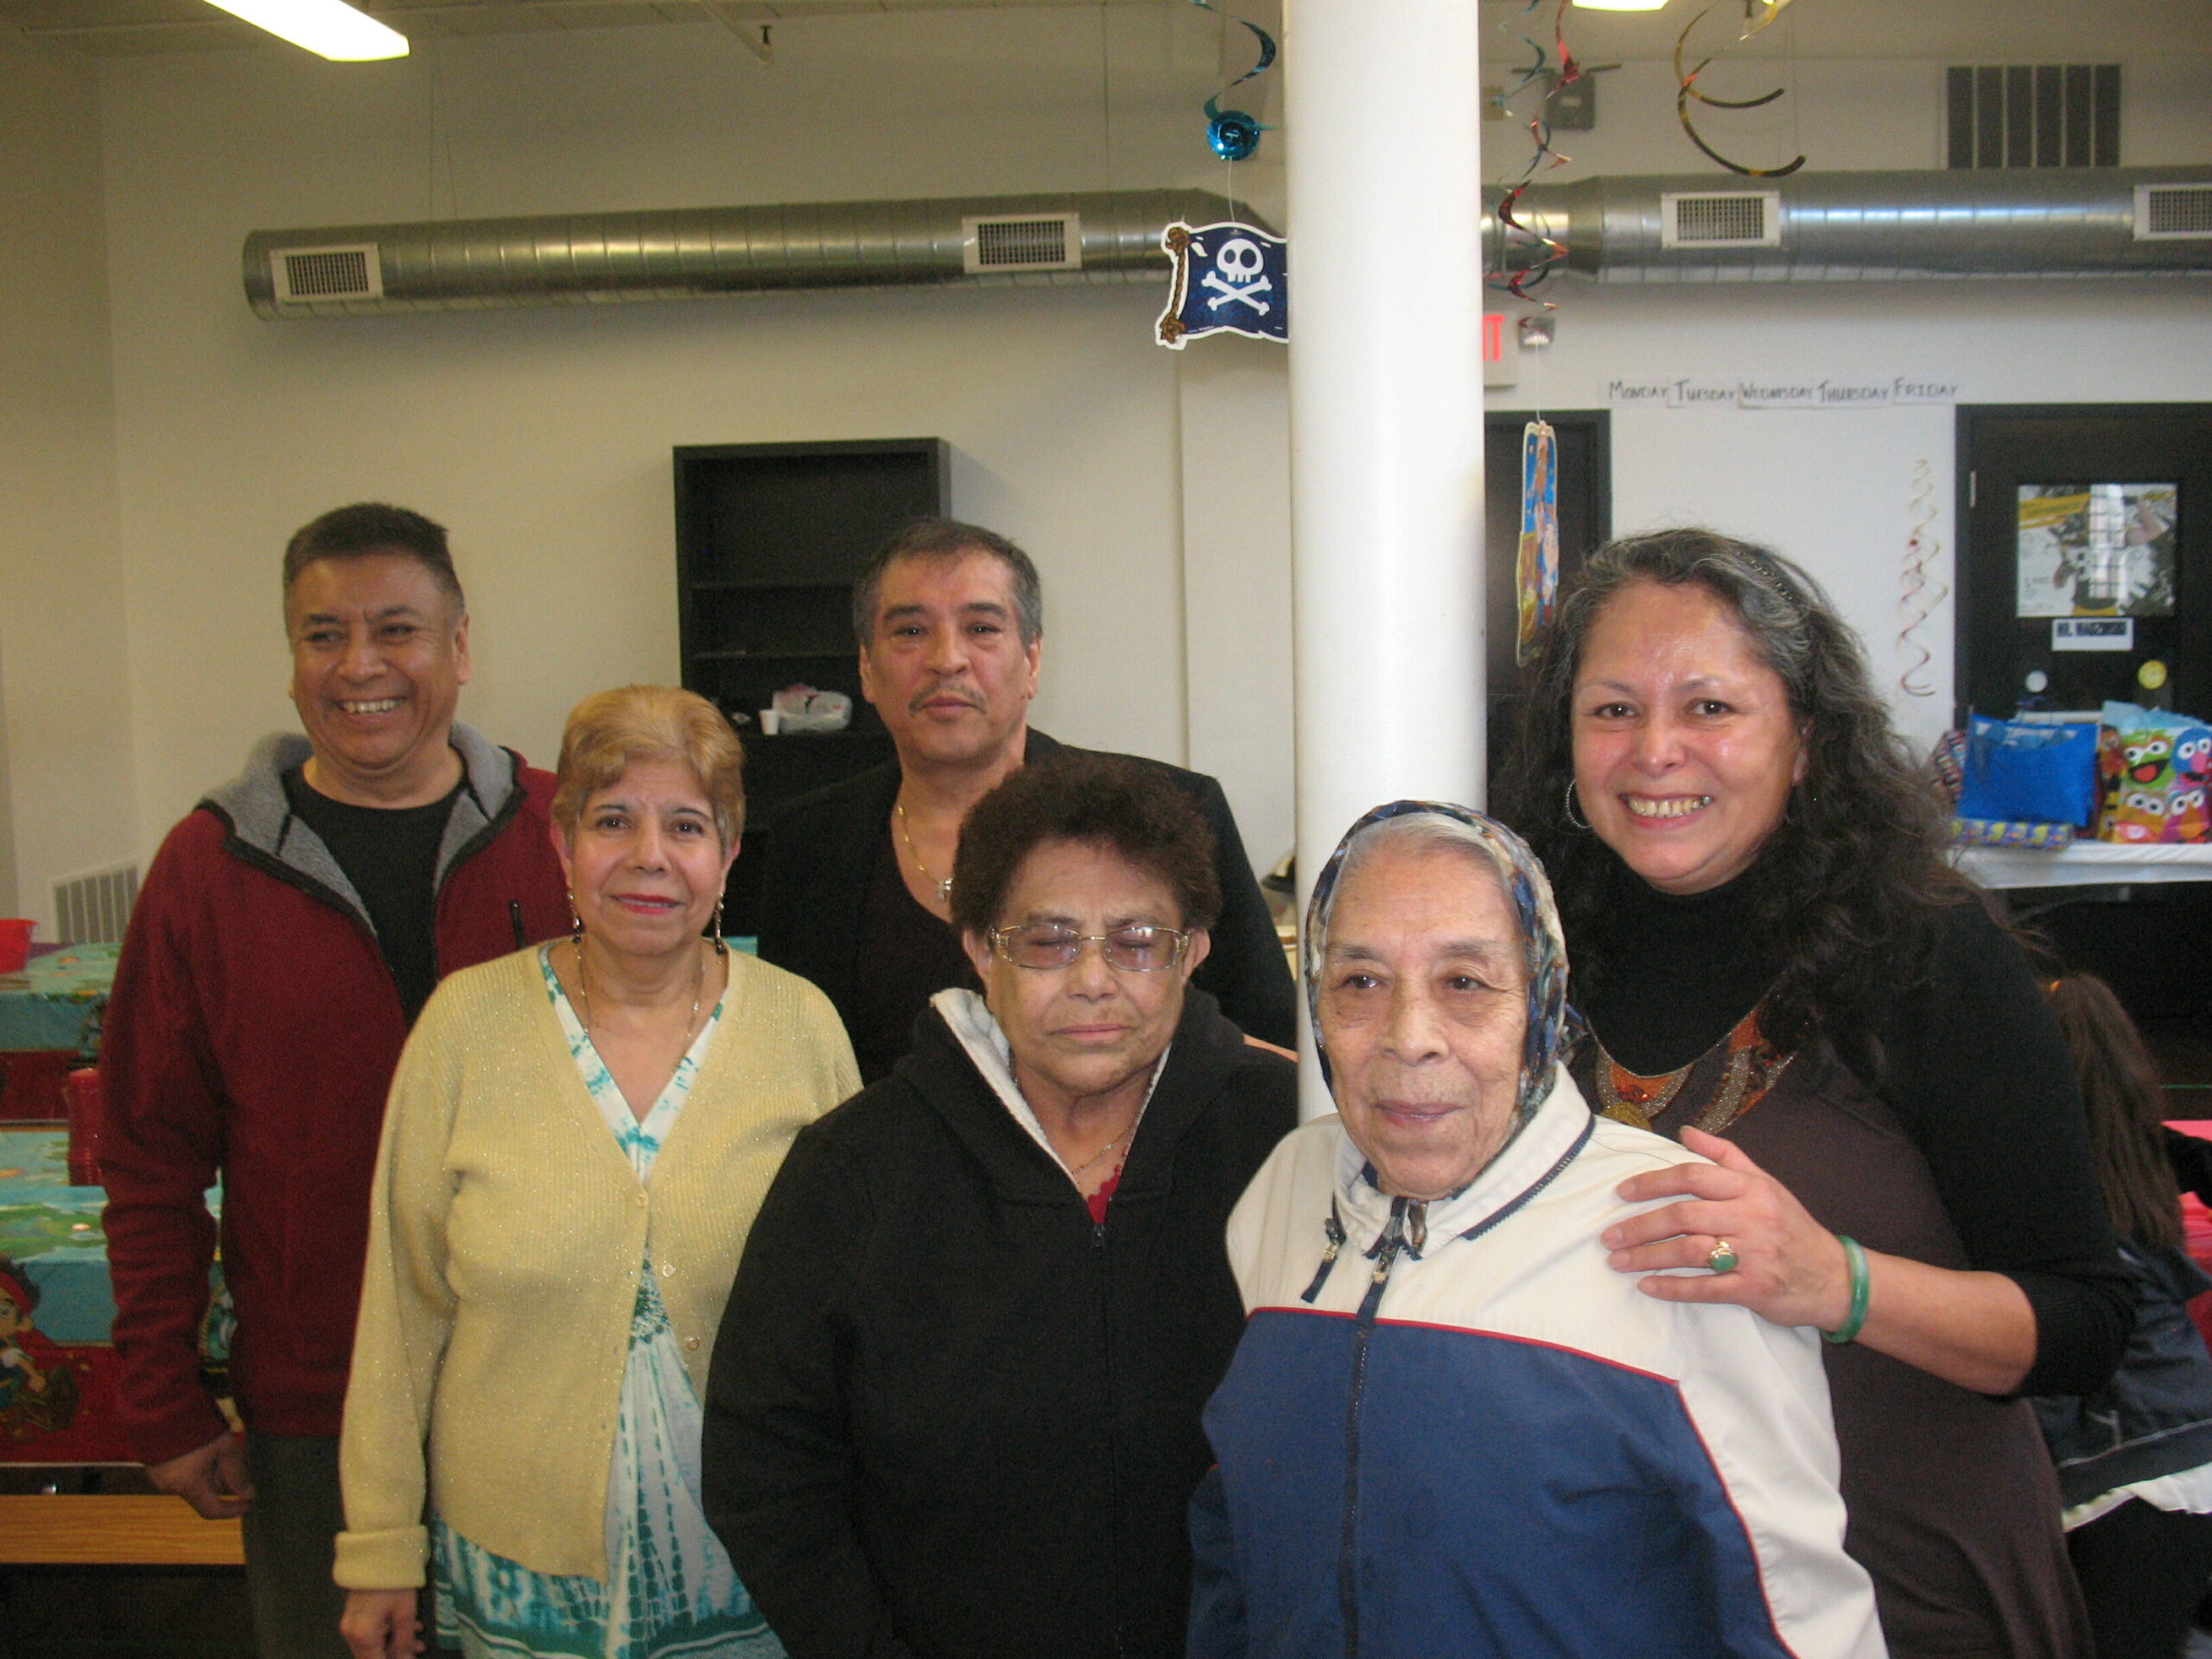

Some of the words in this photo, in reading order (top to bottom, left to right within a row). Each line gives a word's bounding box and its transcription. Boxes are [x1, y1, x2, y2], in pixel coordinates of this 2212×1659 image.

[1482, 314, 1505, 361] IT
[1609, 380, 1669, 400] MONDAY
[1675, 379, 1737, 401] TUESDAY
[1818, 380, 1889, 403] THURSDAY
[1894, 378, 1959, 397] FRIDAY
